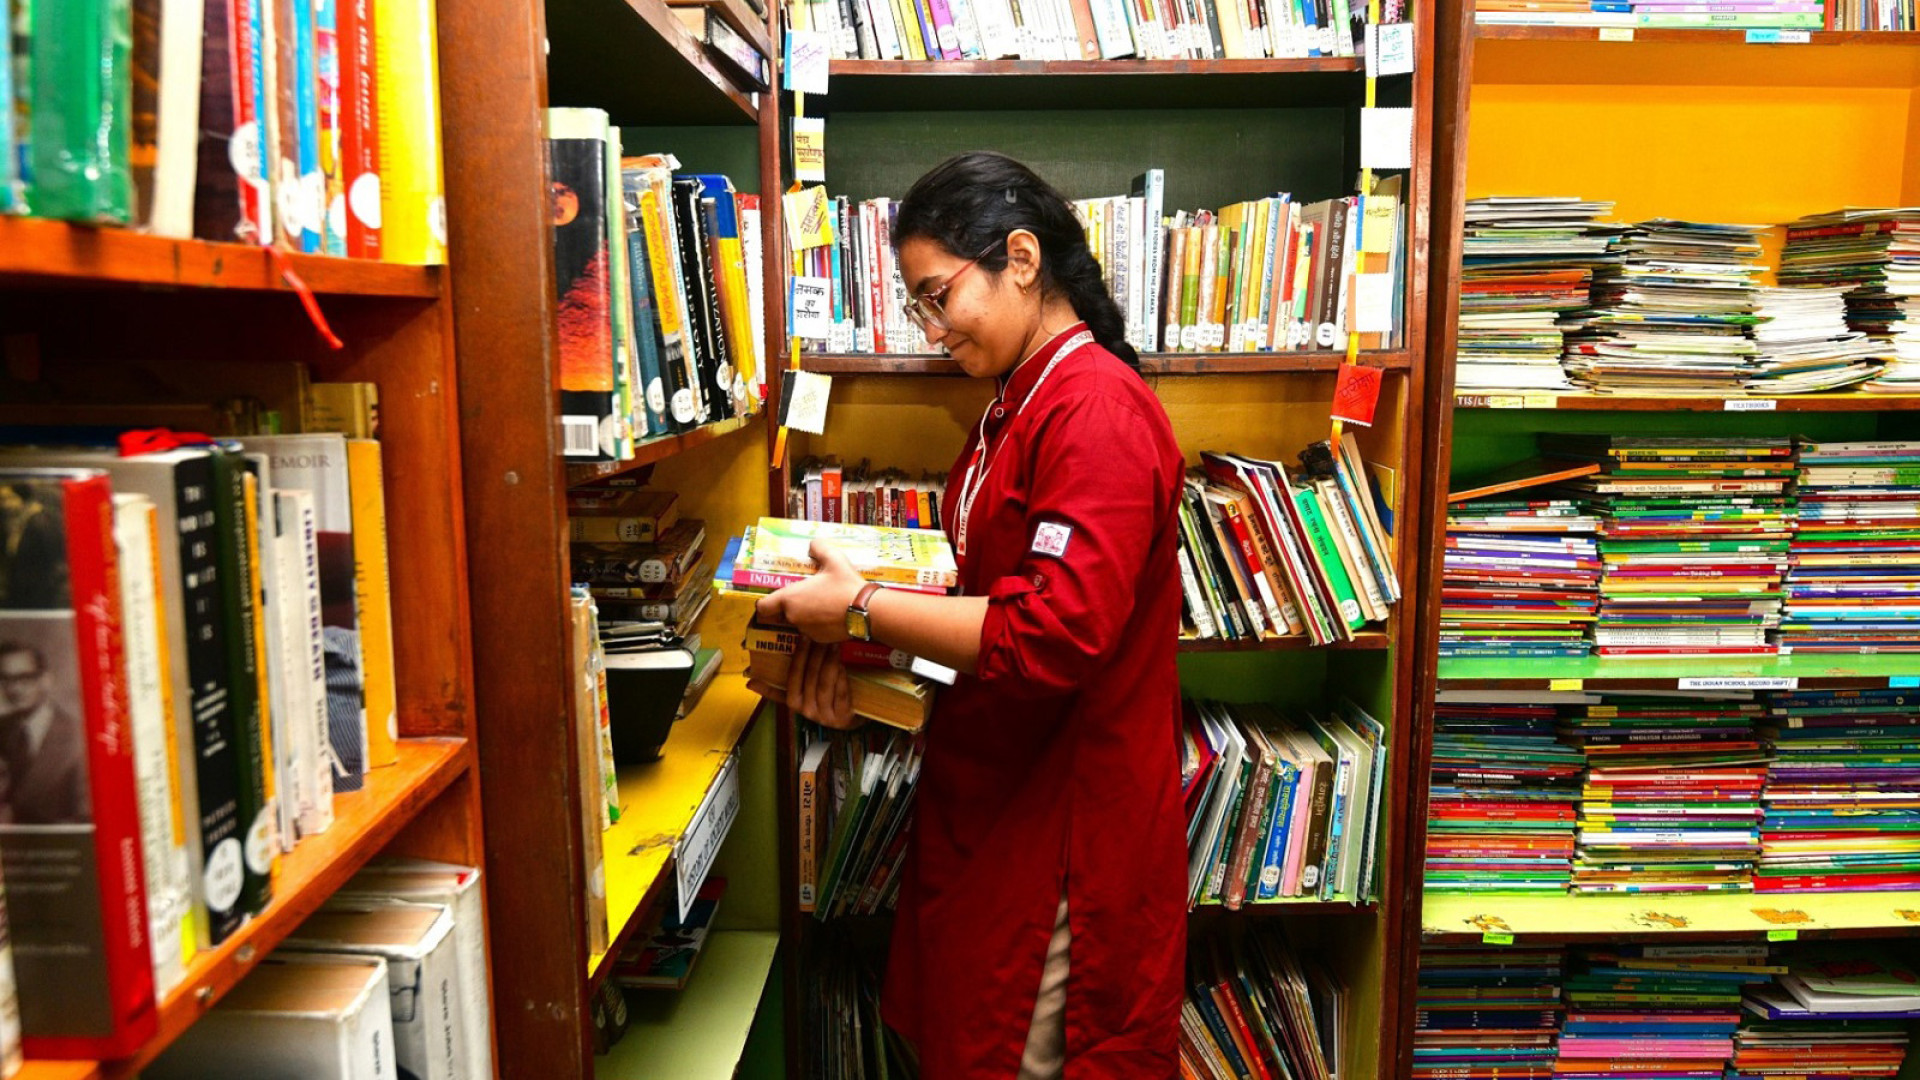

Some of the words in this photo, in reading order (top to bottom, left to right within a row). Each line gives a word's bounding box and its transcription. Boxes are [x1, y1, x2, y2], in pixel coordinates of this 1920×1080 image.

[1149, 288, 1157, 315] JATAKAS
[270, 454, 331, 469] EMOIR
[750, 572, 782, 586] INDIA
[756, 640, 793, 654] INDIAN
